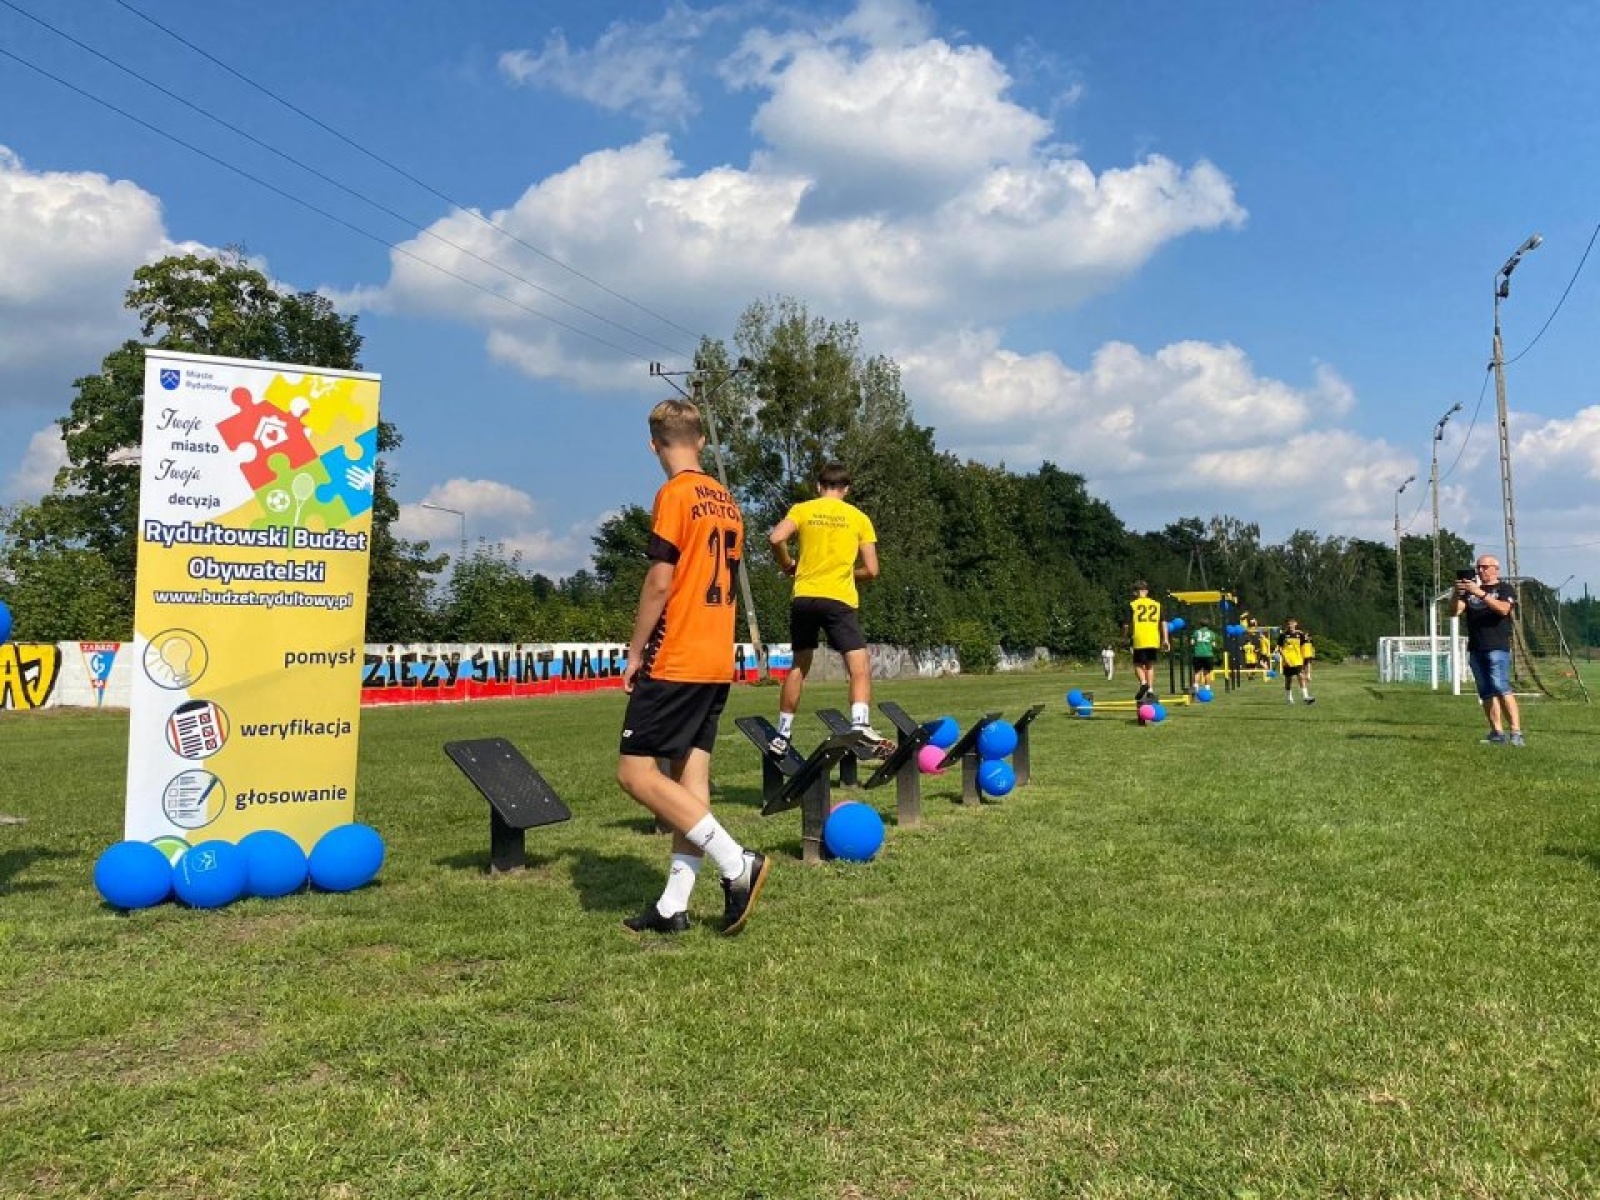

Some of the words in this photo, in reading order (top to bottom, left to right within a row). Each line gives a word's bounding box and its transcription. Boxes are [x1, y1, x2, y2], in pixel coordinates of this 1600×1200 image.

[156, 407, 202, 437] Twoje
[171, 440, 220, 454] miasto
[155, 458, 202, 487] Twoja
[168, 492, 221, 509] decyzja
[144, 519, 288, 547] Rydułtowski
[293, 527, 367, 551] Budżet
[188, 557, 326, 584] Obywatelski
[1137, 604, 1158, 622] 22
[284, 647, 356, 669] pomysł
[240, 718, 351, 740] weryfikacja
[235, 785, 348, 810] głosowanie
